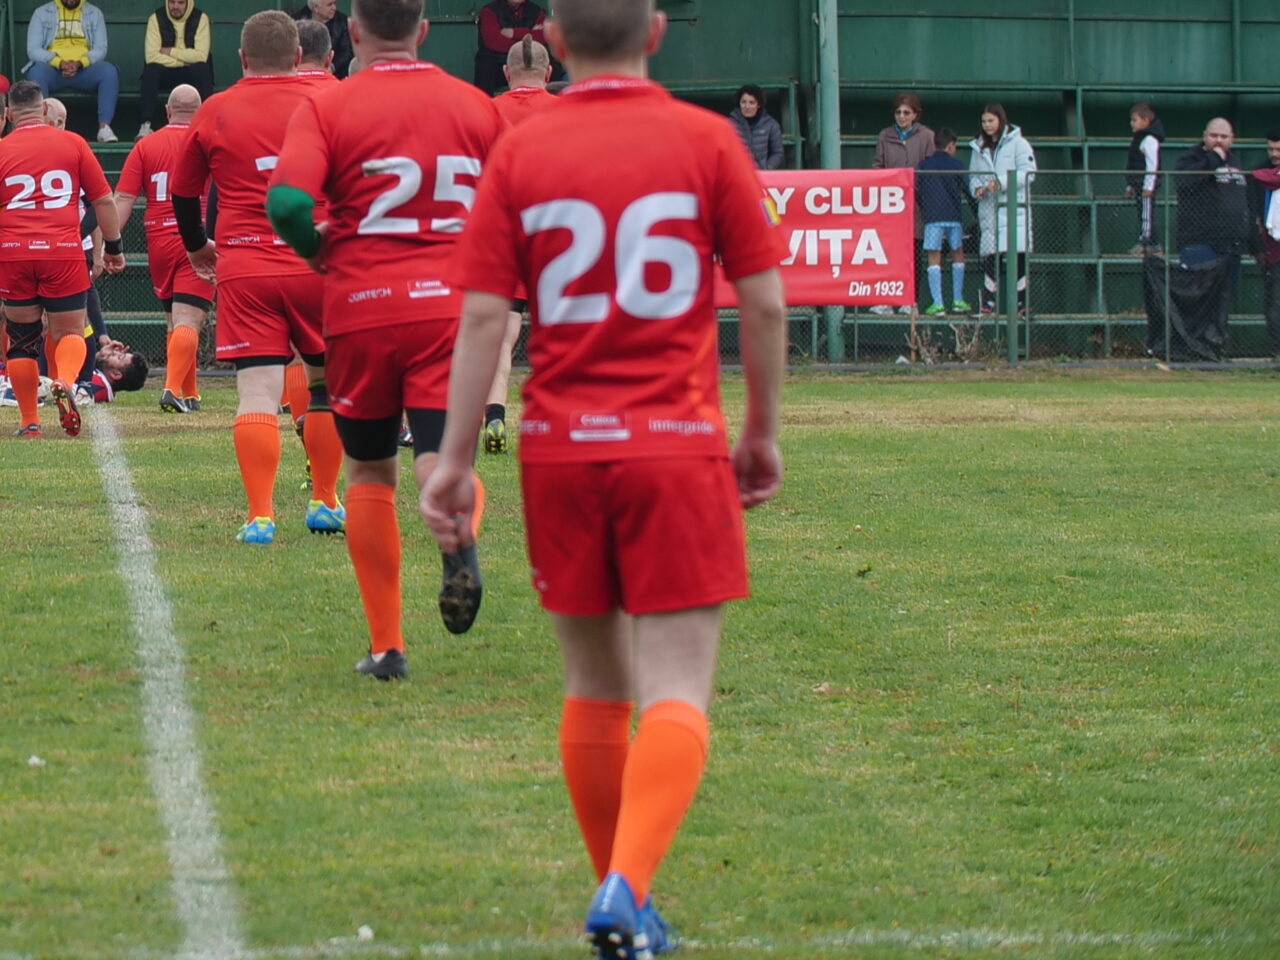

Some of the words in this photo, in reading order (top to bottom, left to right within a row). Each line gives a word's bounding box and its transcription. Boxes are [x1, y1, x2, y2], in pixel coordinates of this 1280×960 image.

[4, 169, 73, 210] 29
[357, 155, 481, 234] 25
[804, 186, 906, 215] CLUB
[521, 191, 701, 326] 26
[849, 281, 871, 296] Din
[874, 281, 904, 296] 1932
